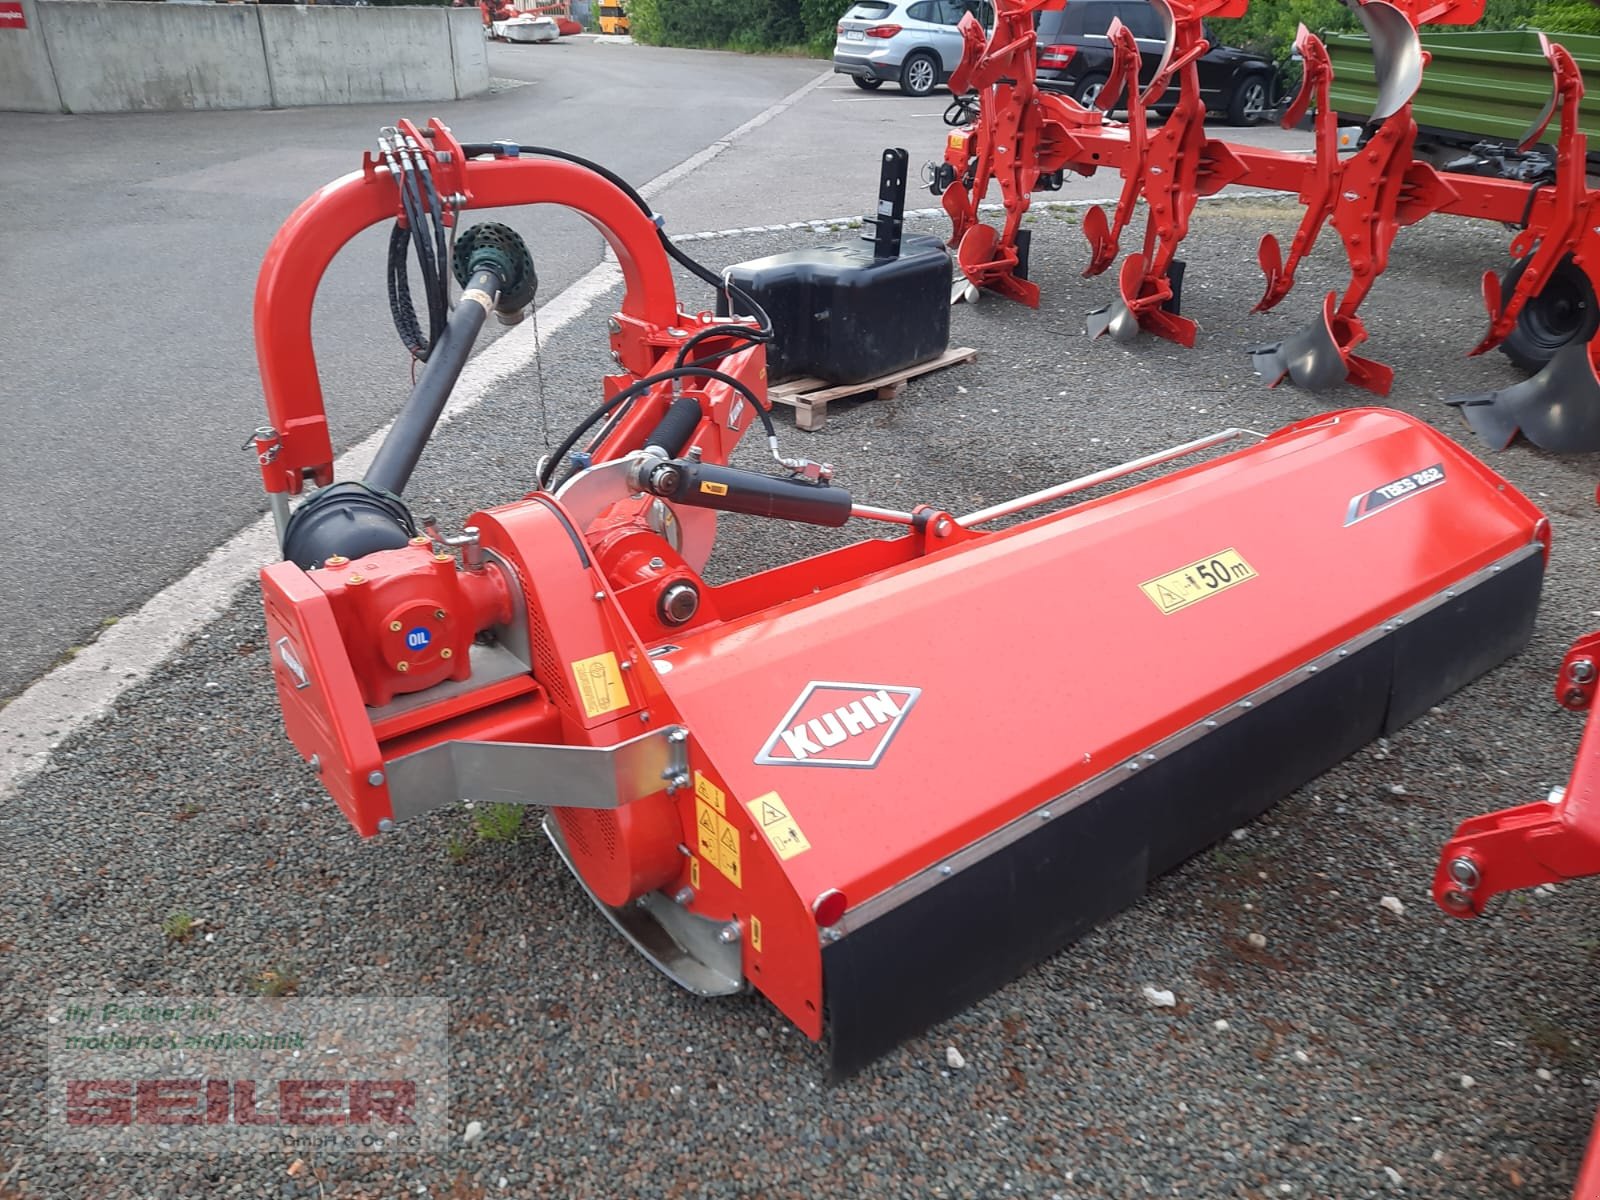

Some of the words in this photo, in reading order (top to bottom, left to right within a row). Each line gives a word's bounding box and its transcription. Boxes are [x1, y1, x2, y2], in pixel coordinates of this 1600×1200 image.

[1412, 467, 1444, 486] 262
[1196, 559, 1231, 589] 50
[1230, 562, 1249, 578] m
[408, 631, 429, 647] OIL
[781, 690, 903, 760] KUHN
